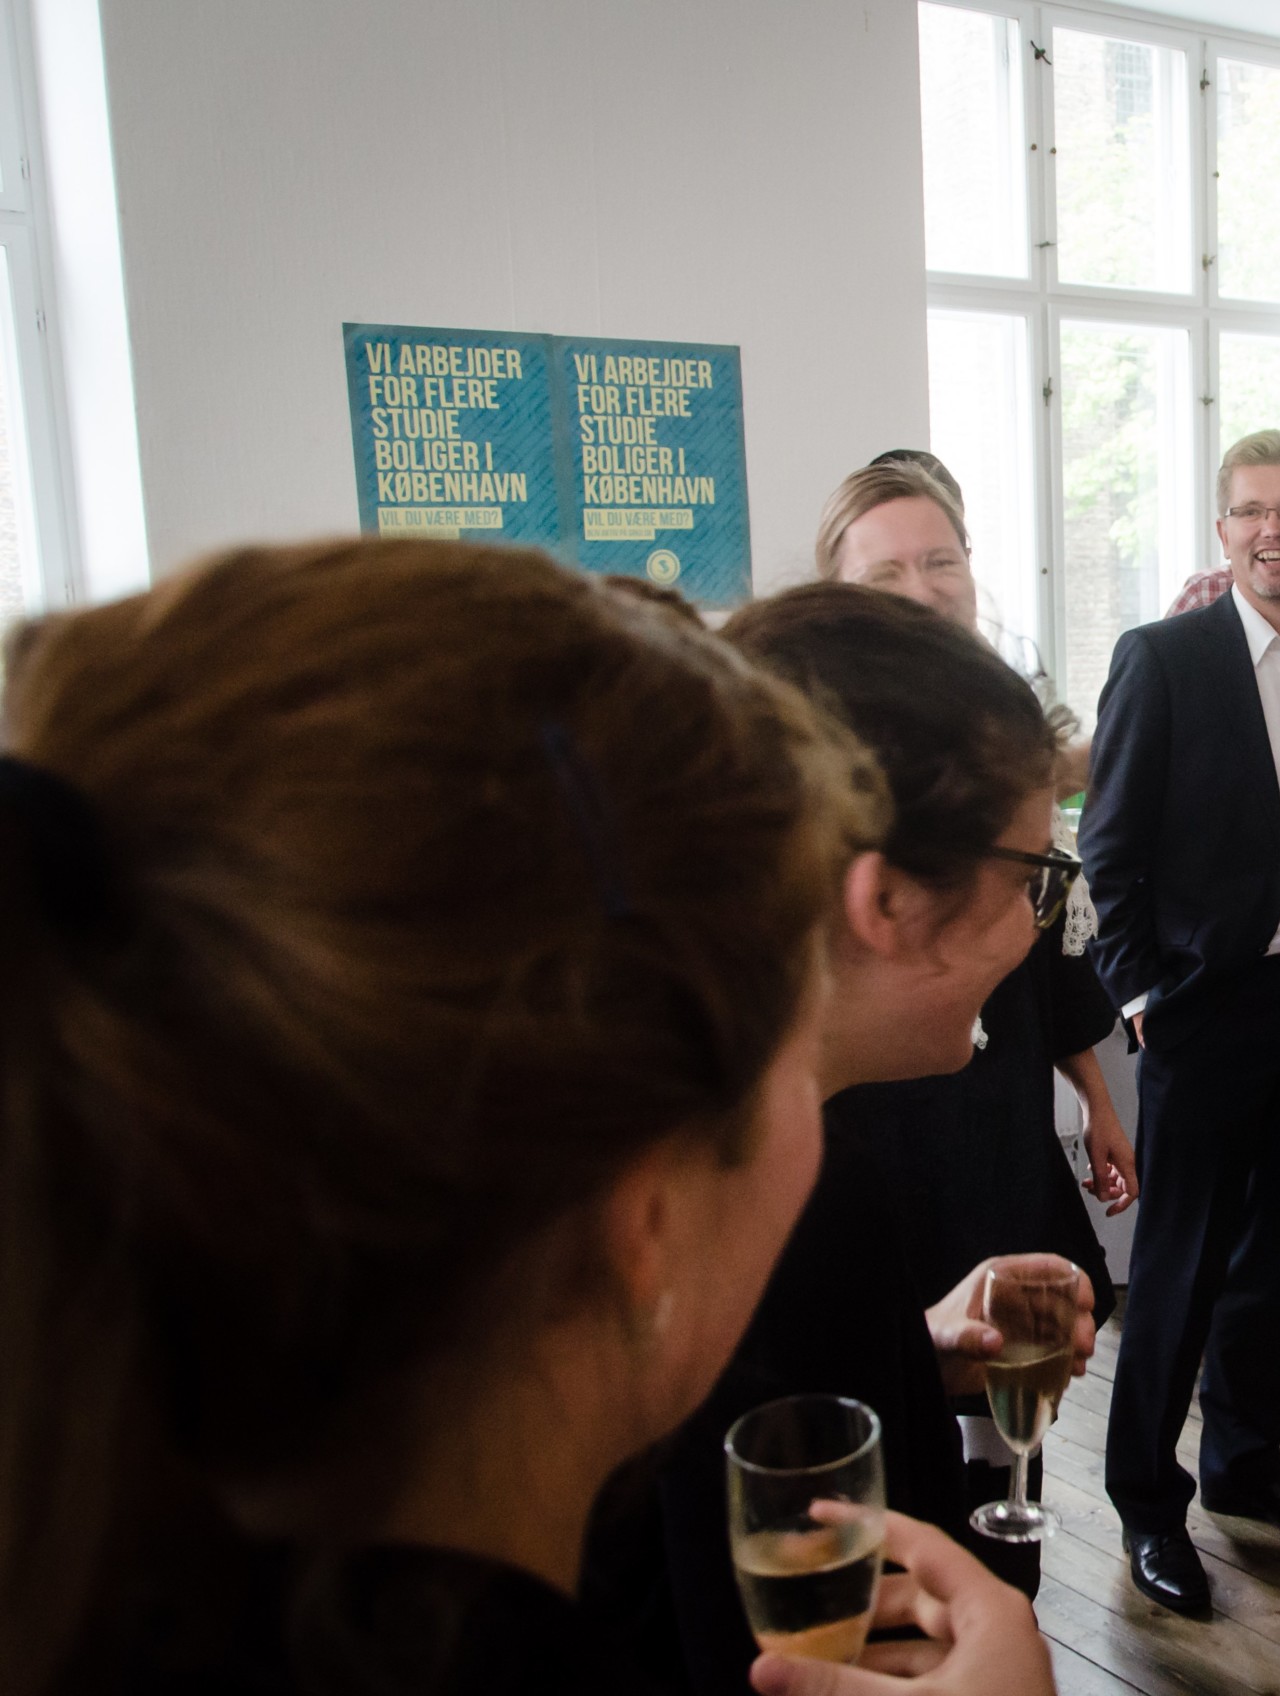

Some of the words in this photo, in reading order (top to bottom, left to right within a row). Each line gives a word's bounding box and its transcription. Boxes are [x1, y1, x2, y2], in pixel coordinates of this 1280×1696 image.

[365, 342, 392, 374] VI
[399, 344, 523, 379] ARBEJDER
[574, 353, 598, 384] VI
[604, 355, 713, 389] ARBEJDER
[368, 375, 418, 407] FOR
[423, 377, 500, 409] FLERE
[577, 384, 621, 415] FOR
[625, 386, 692, 417] FLERE
[371, 407, 461, 440] STUDIE
[579, 414, 658, 445] STUDIE
[375, 439, 480, 471] BOLIGER
[485, 441, 494, 471] I
[582, 444, 674, 475] BOLIGER
[678, 447, 686, 475] I
[377, 471, 527, 503] KØBENHAVN
[583, 475, 715, 506] KØBENHAVN
[381, 510, 400, 526] VIL
[405, 510, 422, 526] DU
[425, 510, 460, 526] VÆRE
[464, 510, 498, 526] MED?
[586, 512, 604, 527] VIL
[607, 512, 622, 527] DU
[624, 512, 656, 527] VÆRE
[659, 512, 690, 527] MED?
